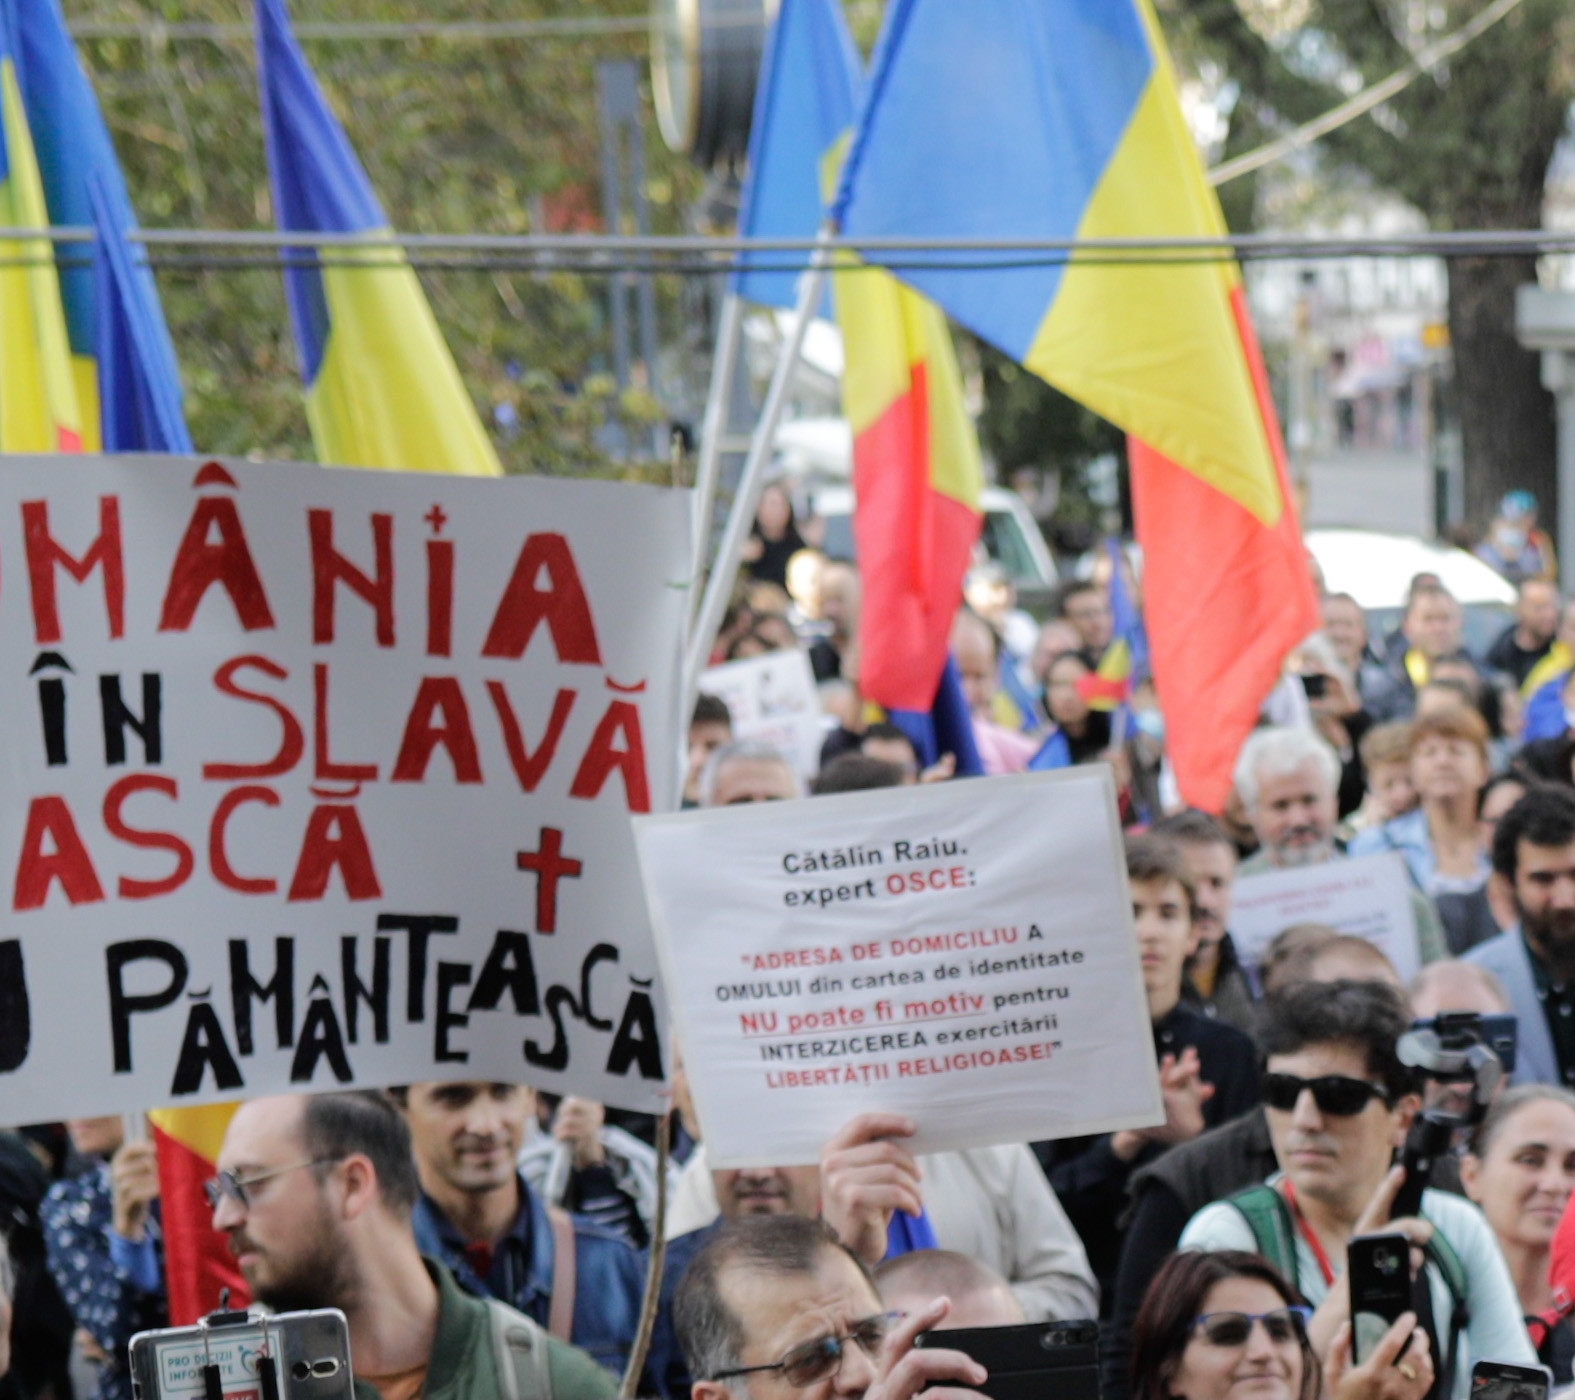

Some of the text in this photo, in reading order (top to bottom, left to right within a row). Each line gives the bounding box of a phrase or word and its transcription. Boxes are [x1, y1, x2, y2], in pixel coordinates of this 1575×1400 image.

[29, 650, 165, 766] ÎN
[203, 655, 652, 813] SLAVĂ
[782, 843, 883, 875] Cătălin
[785, 866, 976, 909] expert OSCE:
[851, 942, 881, 962] DE
[891, 926, 1017, 958] DOMICILIU
[1026, 923, 1044, 941] A
[716, 947, 1085, 1003] OMULUI din cartea de identitate
[105, 912, 665, 1096] PĂMÂNTEASCĂ
[740, 985, 1069, 1034] NU poate fi motiv pentru
[760, 1014, 1058, 1061] INTERZICEREA exercitării
[167, 1355, 190, 1367] PRO
